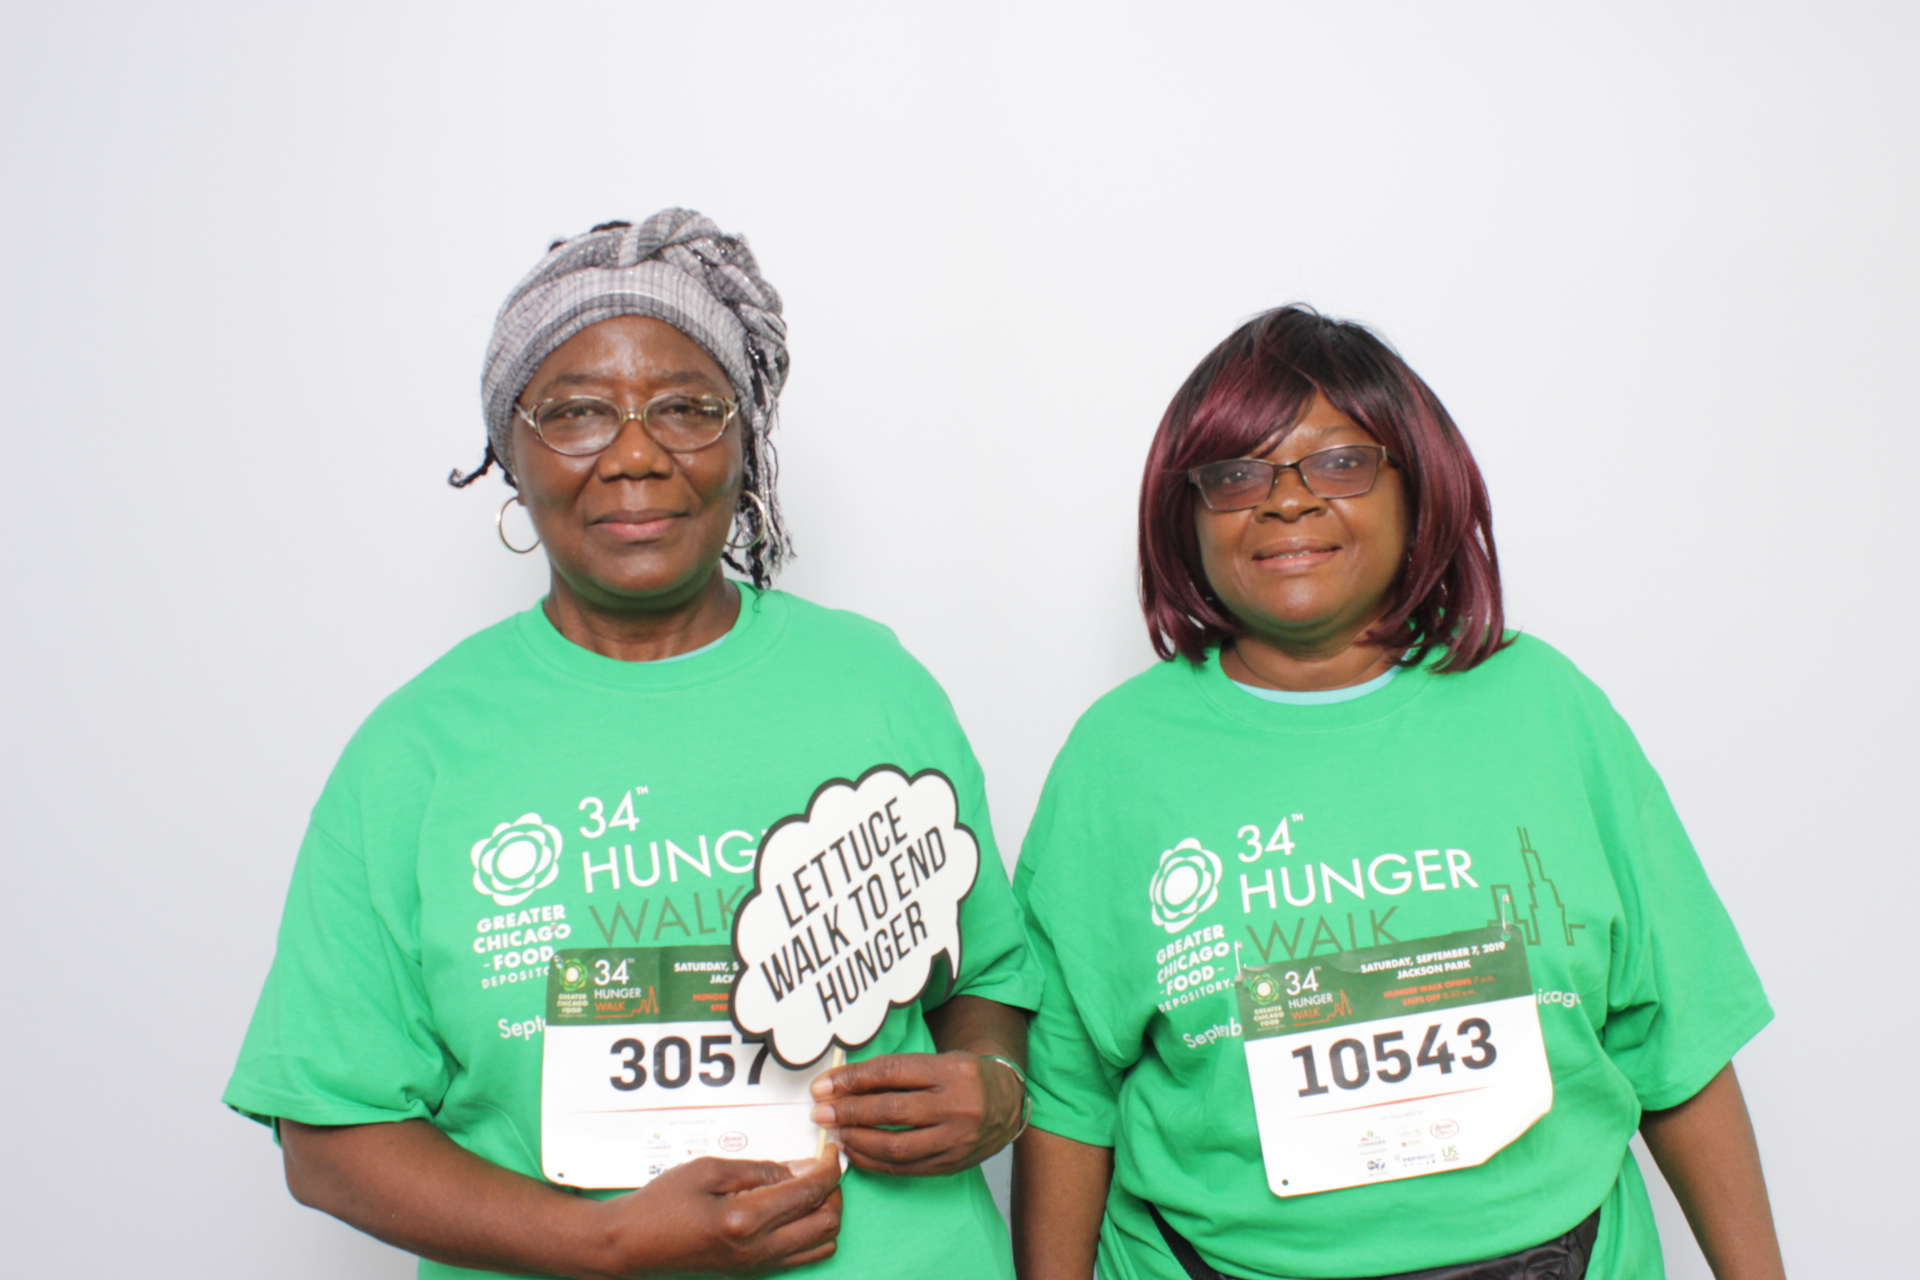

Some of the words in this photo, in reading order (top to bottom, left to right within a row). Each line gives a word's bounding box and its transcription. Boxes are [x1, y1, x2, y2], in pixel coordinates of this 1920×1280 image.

[582, 829, 767, 893] HUNG
[776, 796, 908, 929] LETTUCE
[1240, 848, 1479, 913] HUNGER
[476, 904, 566, 933] GREATER
[588, 884, 746, 947] WALK
[760, 903, 851, 1003] WALK
[847, 874, 889, 932] TO
[889, 826, 947, 902] END
[473, 923, 571, 954] CHICAGO
[1157, 924, 1225, 965] GREATER
[1245, 906, 1399, 964] WALK
[674, 962, 729, 973] SATURDAY,
[816, 901, 928, 1024] HUNGER
[1157, 941, 1230, 984] CHICAGO
[1360, 956, 1414, 974] SATURDAY,
[1416, 946, 1470, 964] SEPTEMBER
[1471, 945, 1480, 956] 7,
[1482, 941, 1506, 954] 2019
[1397, 963, 1443, 979] JACKSON
[1444, 959, 1472, 972] PARK
[594, 987, 642, 1000] HUNGER
[1288, 993, 1333, 1009] HUNGER
[1384, 984, 1419, 998] HUNGER
[1419, 981, 1443, 993] WALK
[1444, 978, 1472, 989] OPENS
[1402, 995, 1425, 1006] STEPS
[1425, 993, 1442, 1002] OFF
[1537, 988, 1581, 1008] icag
[594, 1001, 626, 1012] WALK
[1253, 1011, 1285, 1022] CHICAGO
[1254, 1005, 1282, 1015] GREATER
[1291, 1008, 1320, 1020] WALK
[609, 1034, 770, 1092] 3057
[1291, 1017, 1498, 1098] 10543
